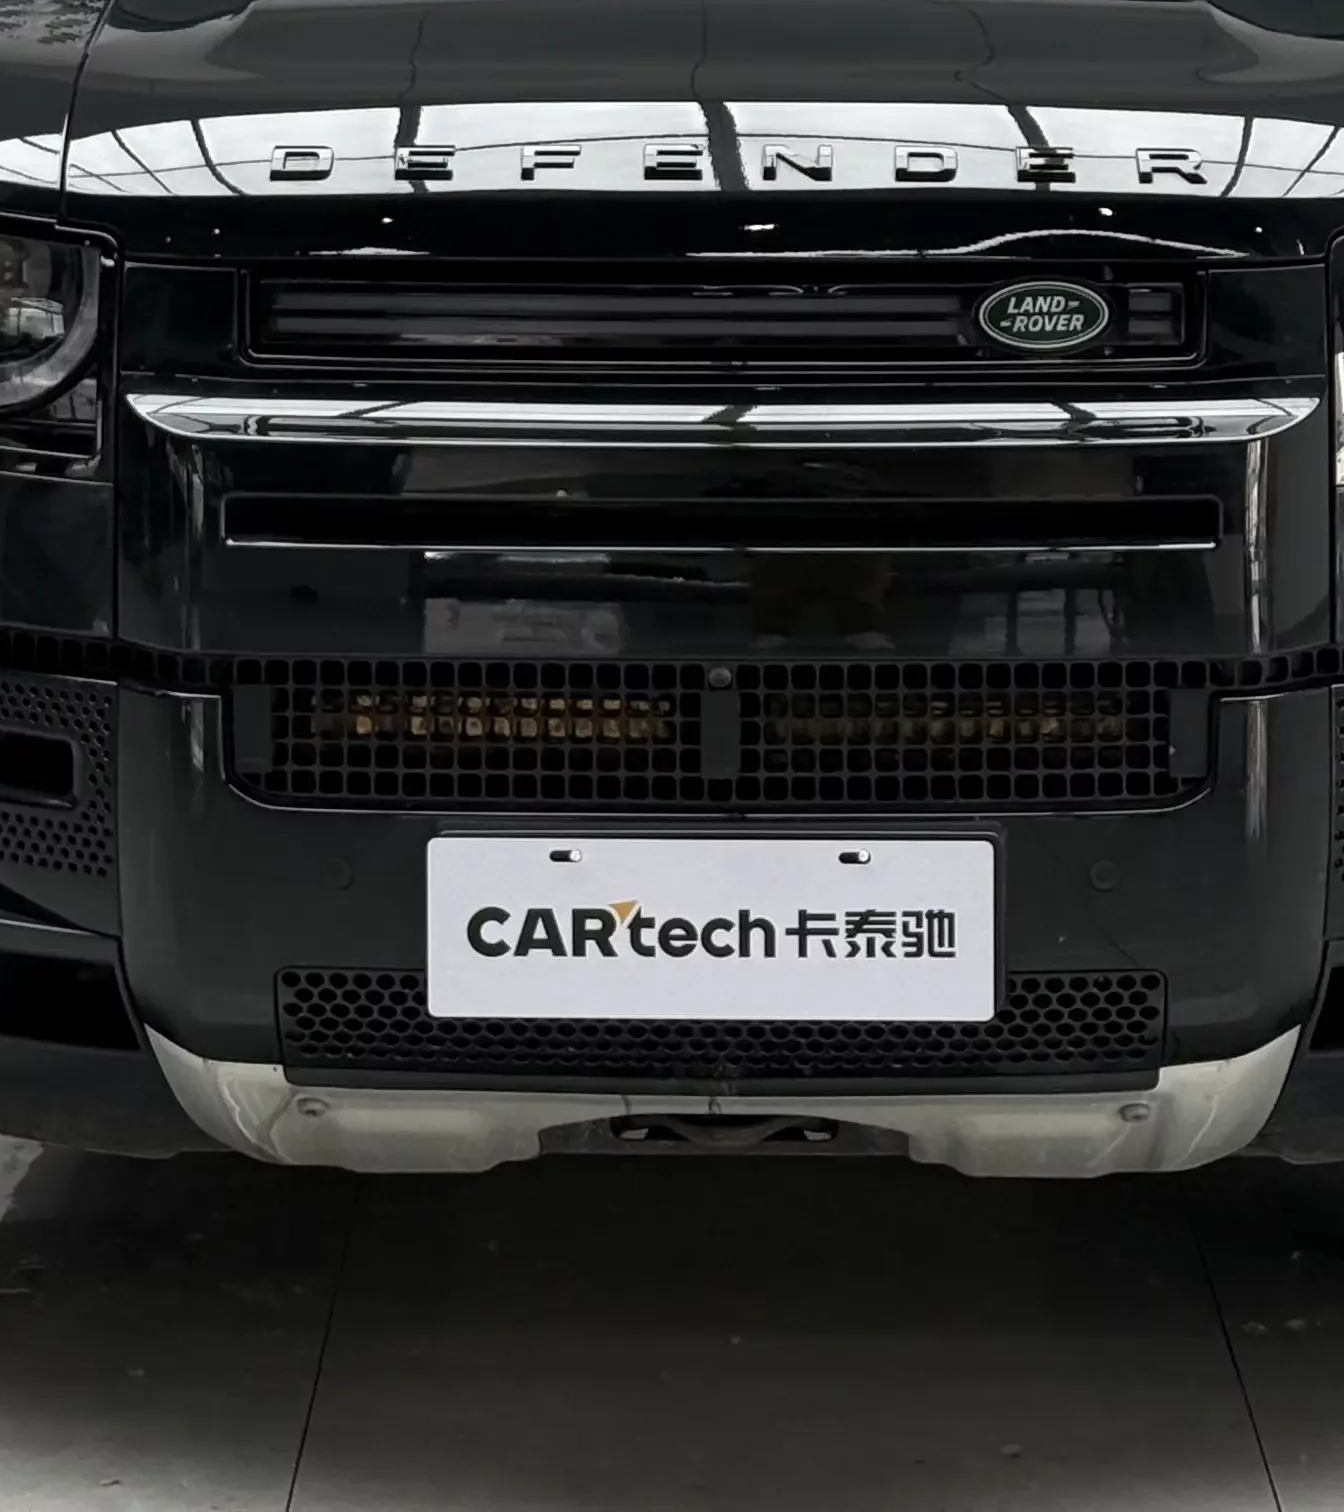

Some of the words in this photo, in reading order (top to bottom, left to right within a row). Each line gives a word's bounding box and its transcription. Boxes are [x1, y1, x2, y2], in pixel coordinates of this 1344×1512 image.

[267, 144, 1208, 185] DEFENDER
[784, 908, 957, 959] 卡泰驰
